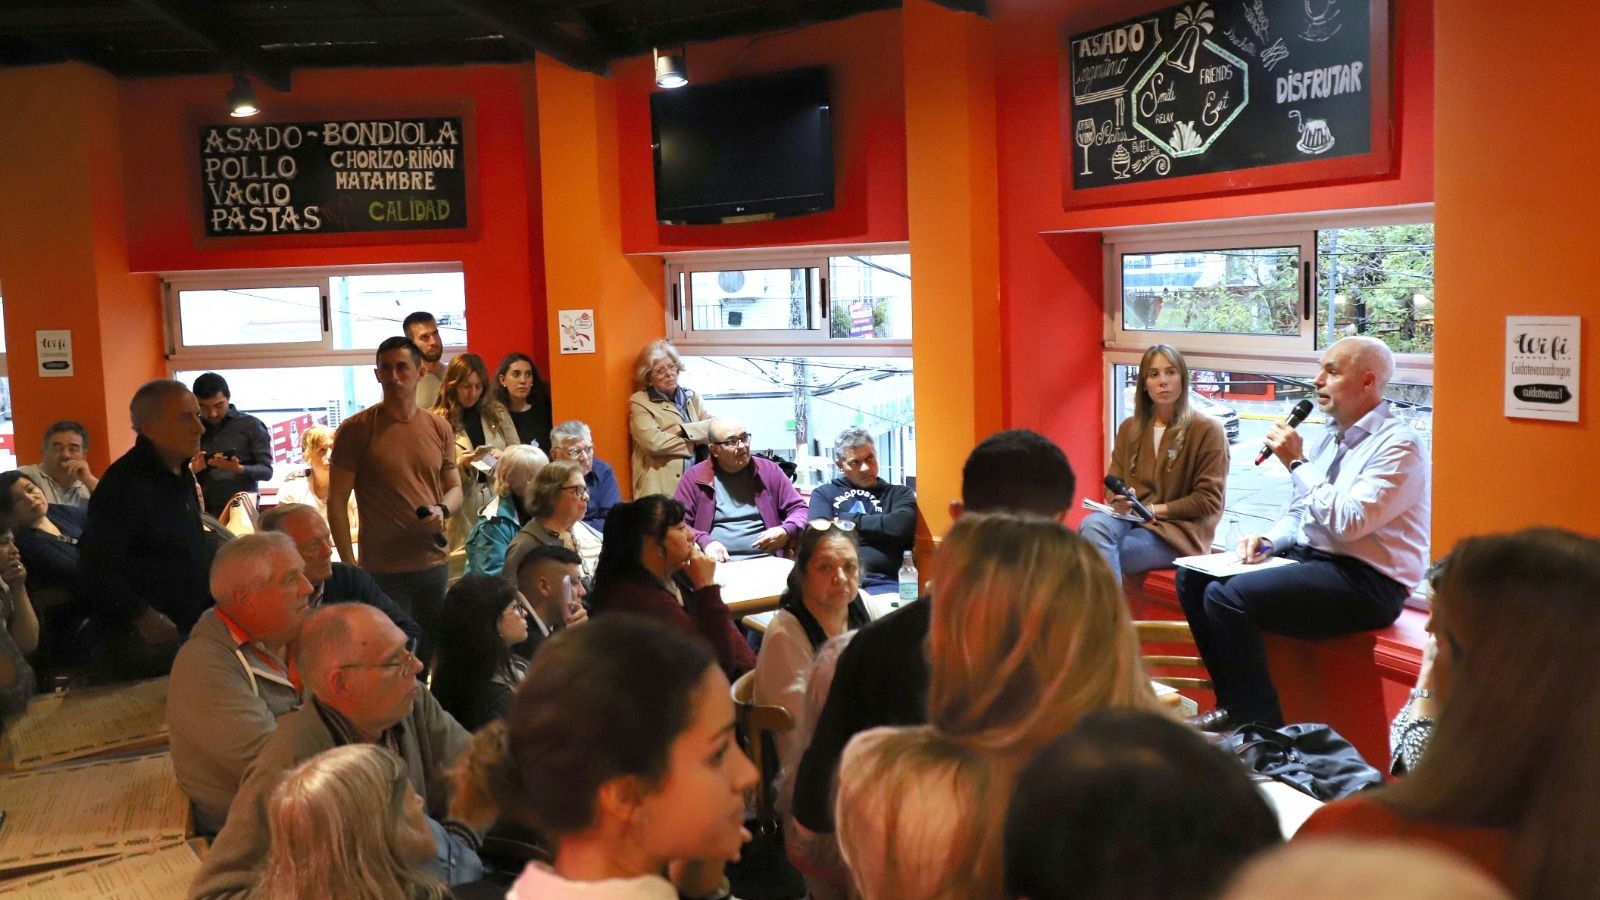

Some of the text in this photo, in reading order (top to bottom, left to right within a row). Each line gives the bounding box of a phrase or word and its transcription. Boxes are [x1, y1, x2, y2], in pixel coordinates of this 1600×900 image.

[1079, 23, 1145, 58] ASADO
[1155, 112, 1175, 124] RELAX
[204, 125, 303, 153] ASADO
[322, 120, 459, 147] BONDIOLA
[205, 155, 297, 182] POLLO
[335, 171, 436, 191] MATAMBRE
[207, 181, 291, 206] VACIO
[211, 205, 322, 233] PASTAS
[368, 199, 451, 222] CALIDAD
